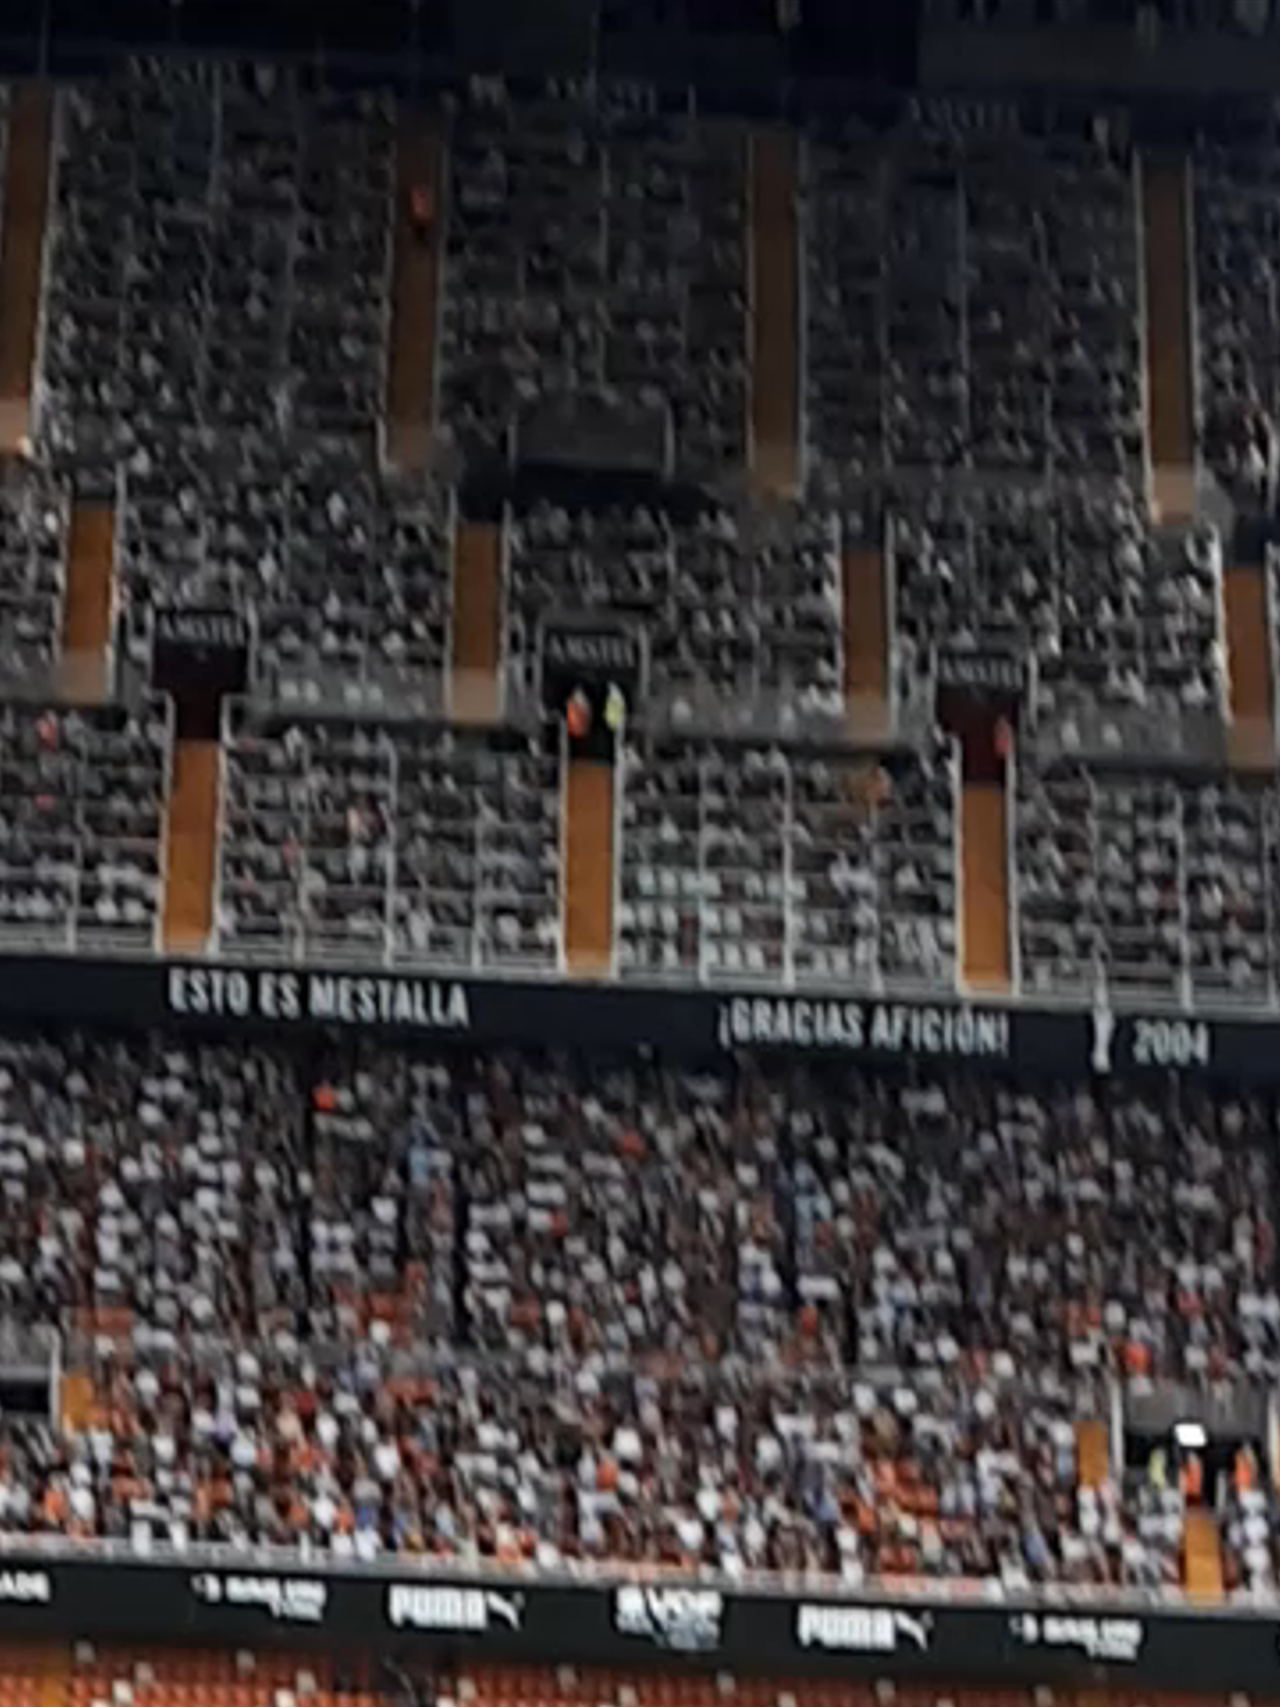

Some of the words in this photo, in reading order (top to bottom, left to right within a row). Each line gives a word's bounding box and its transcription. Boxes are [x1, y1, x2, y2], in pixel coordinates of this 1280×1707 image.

[169, 967, 249, 1016] ESTO
[258, 972, 300, 1018] ES
[308, 974, 469, 1028] MESTALLA
[1134, 1020, 1208, 1065] 2004
